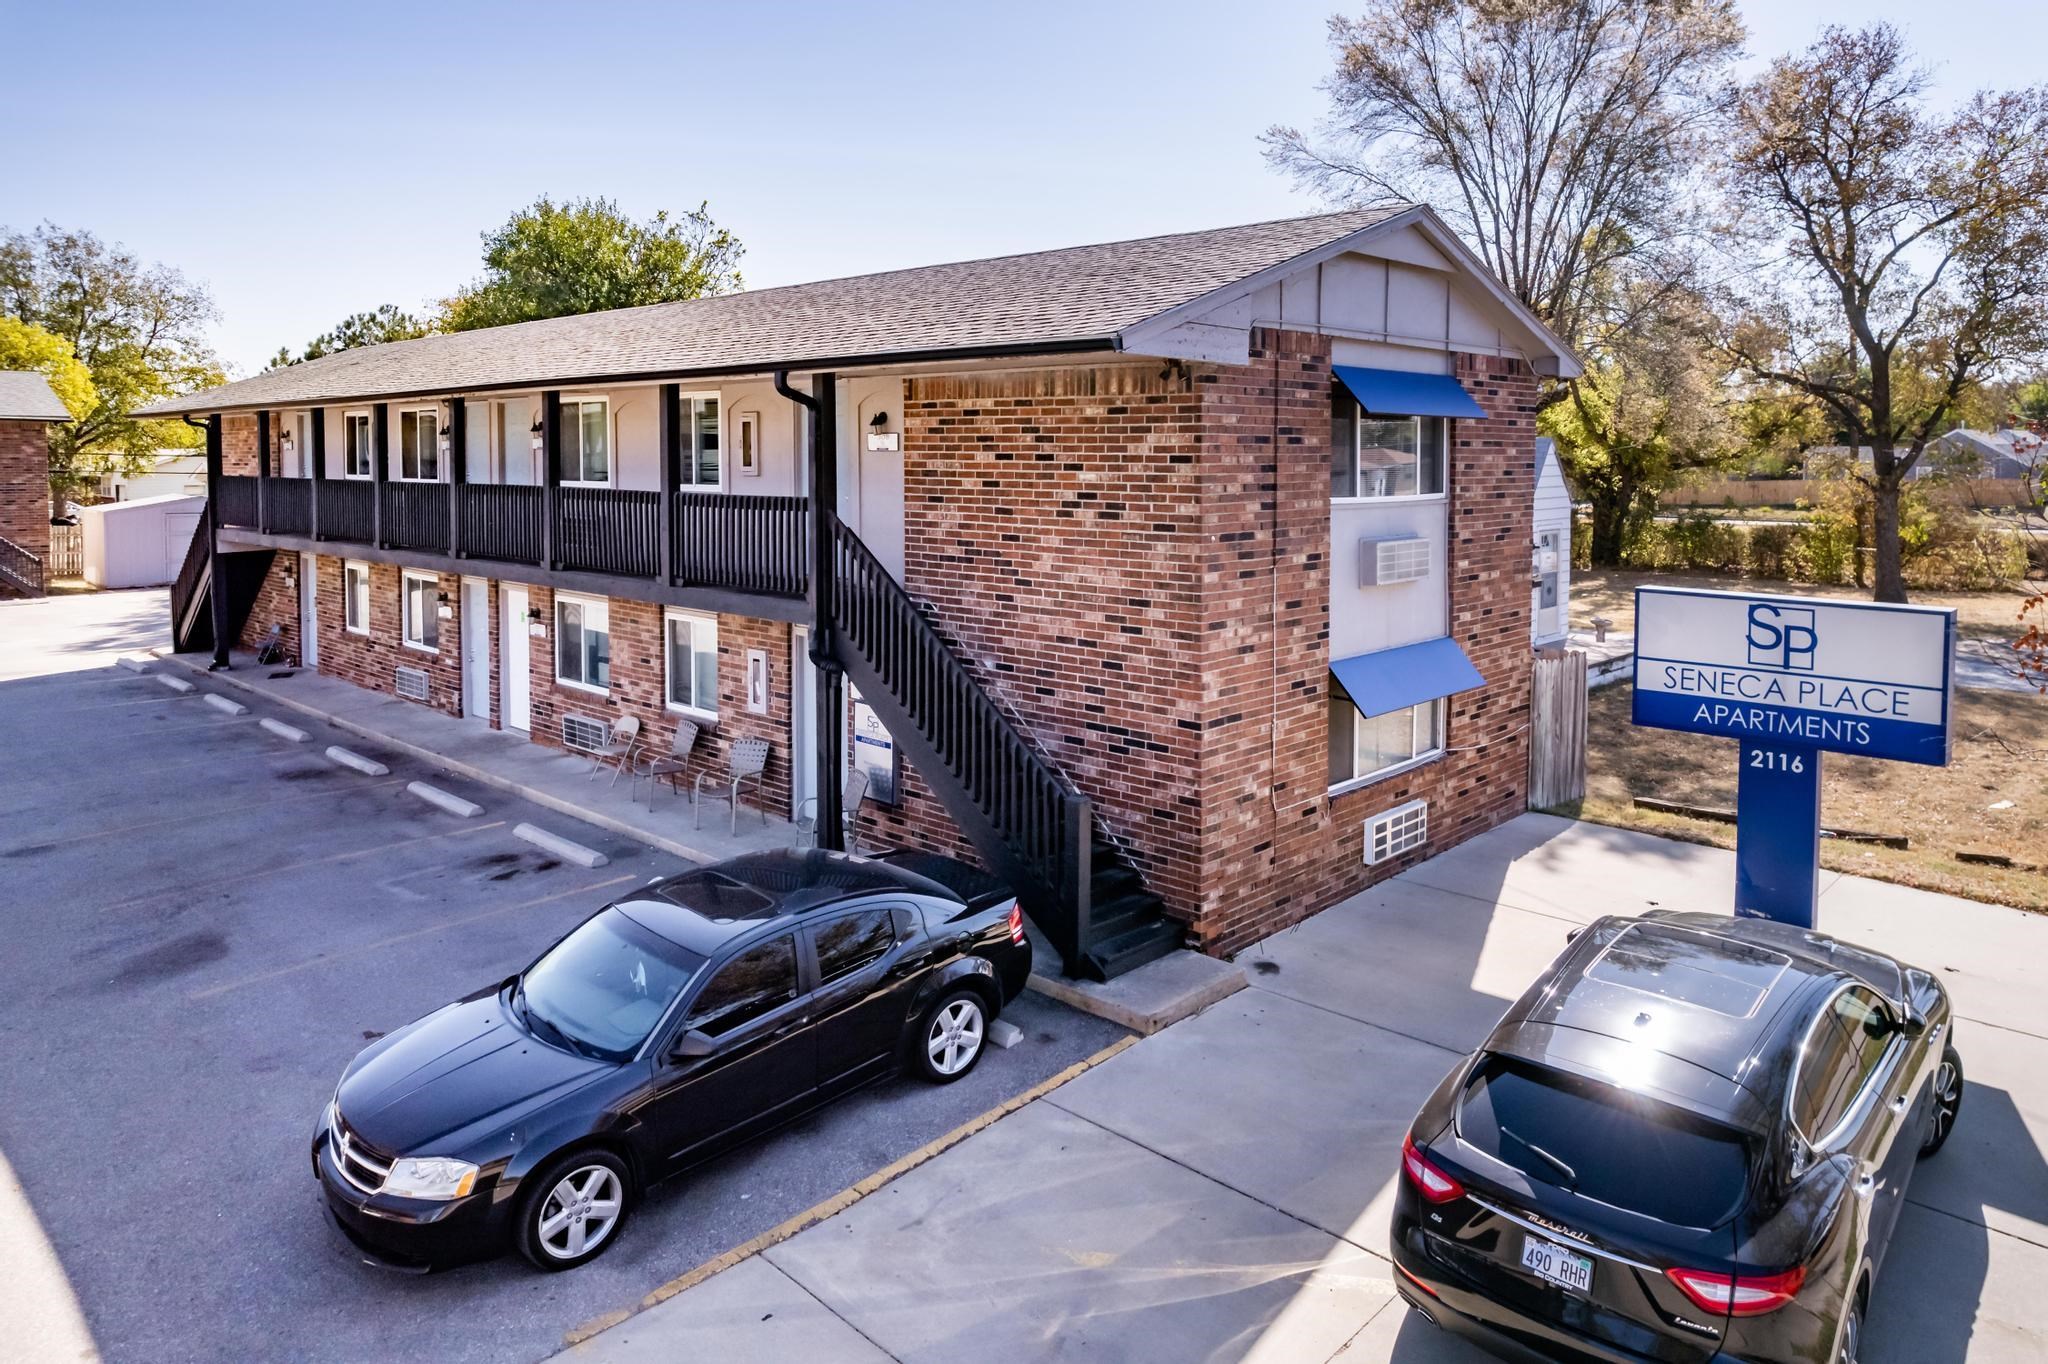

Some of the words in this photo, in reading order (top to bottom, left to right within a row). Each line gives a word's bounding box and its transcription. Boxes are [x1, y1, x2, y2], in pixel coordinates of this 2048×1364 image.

[1746, 604, 1818, 670] SP
[1663, 666, 1787, 702] SENECA
[1799, 681, 1910, 716] PLACE
[1693, 703, 1871, 745] APARTMENTS
[1750, 750, 1804, 774] 2116
[1526, 1248, 1552, 1272] 490
[1560, 1260, 1587, 1288] RHR
